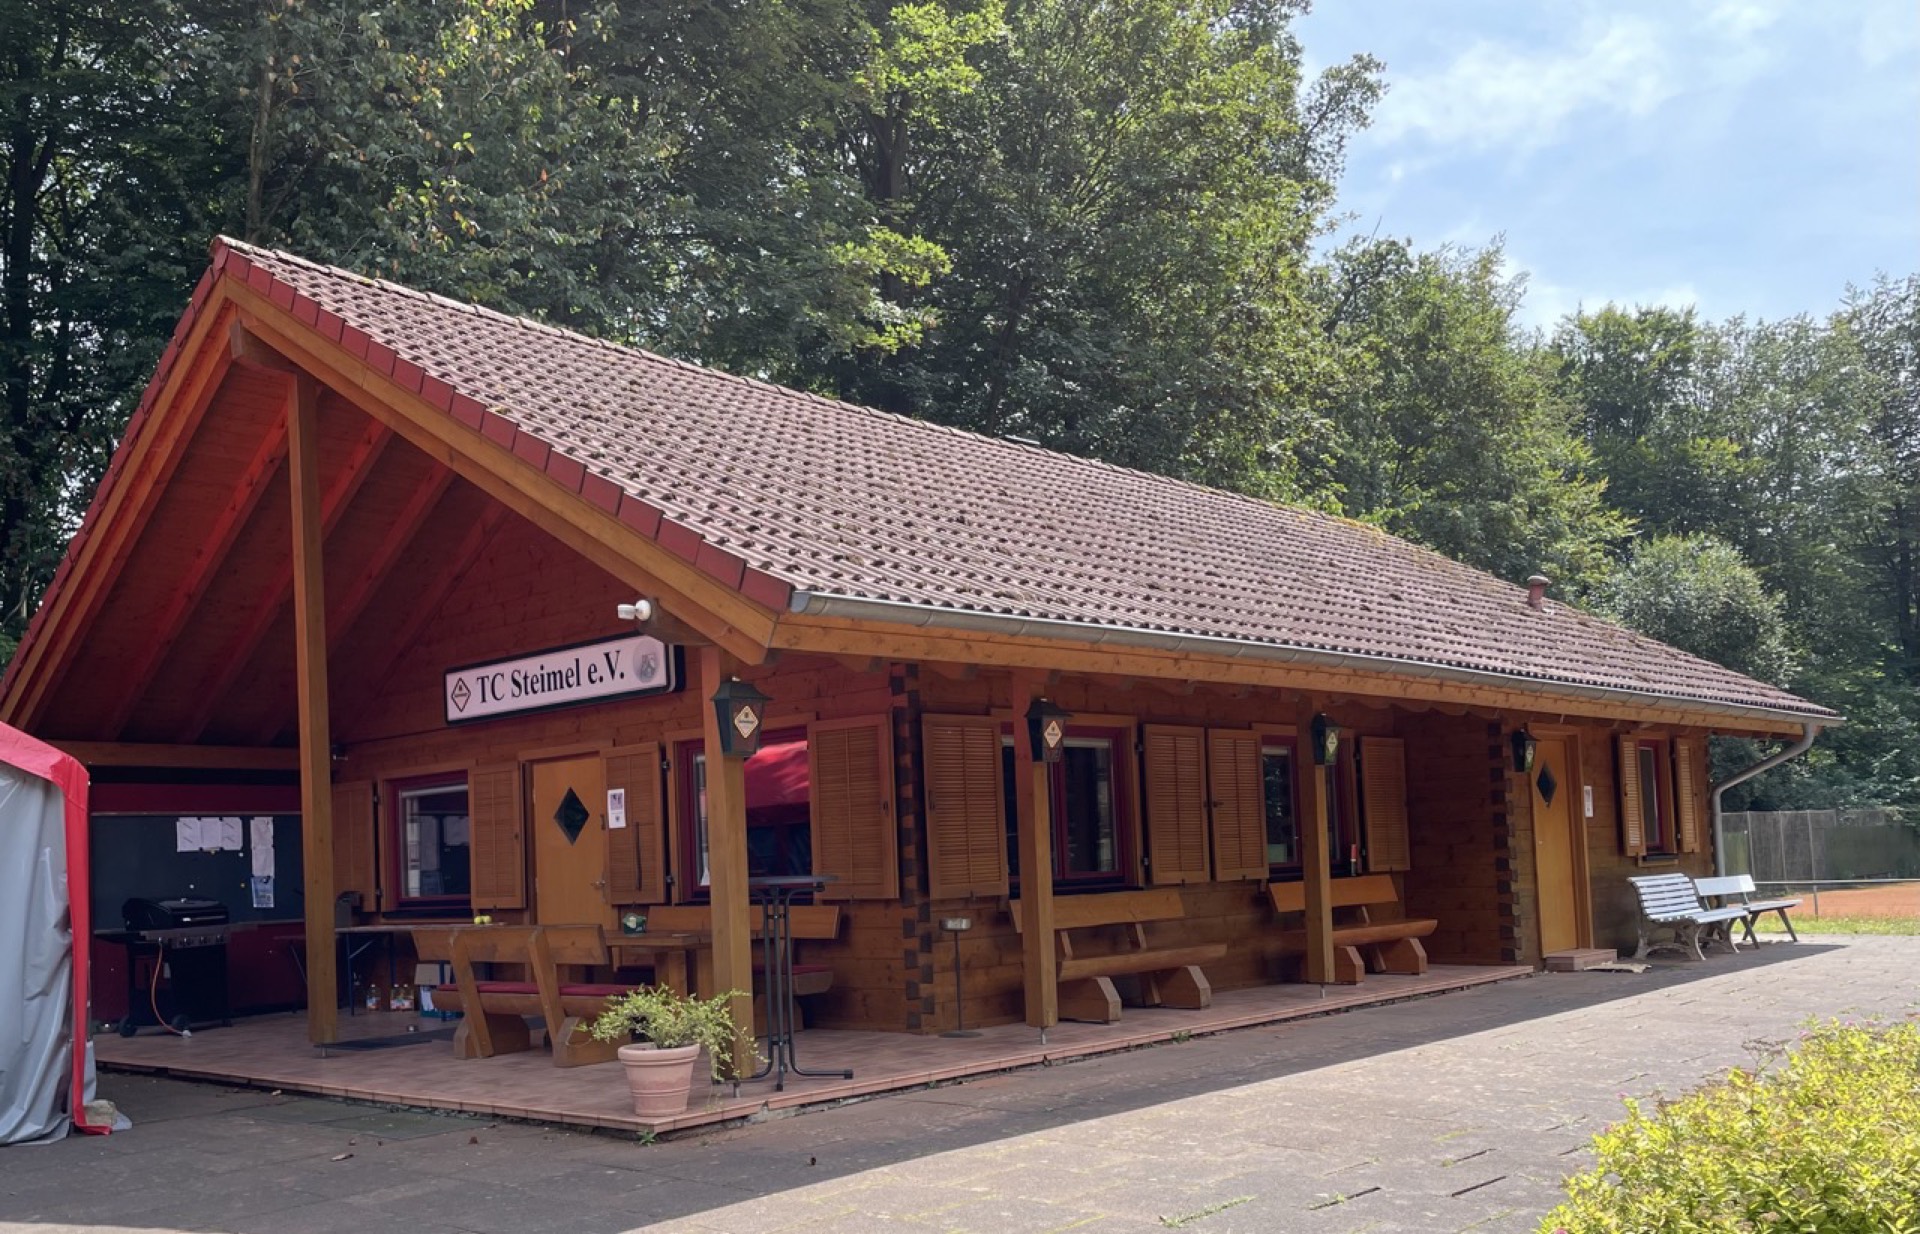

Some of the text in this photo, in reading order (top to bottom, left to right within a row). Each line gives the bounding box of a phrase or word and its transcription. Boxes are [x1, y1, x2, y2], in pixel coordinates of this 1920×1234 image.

[476, 650, 625, 703] TC Steimel e.V.
